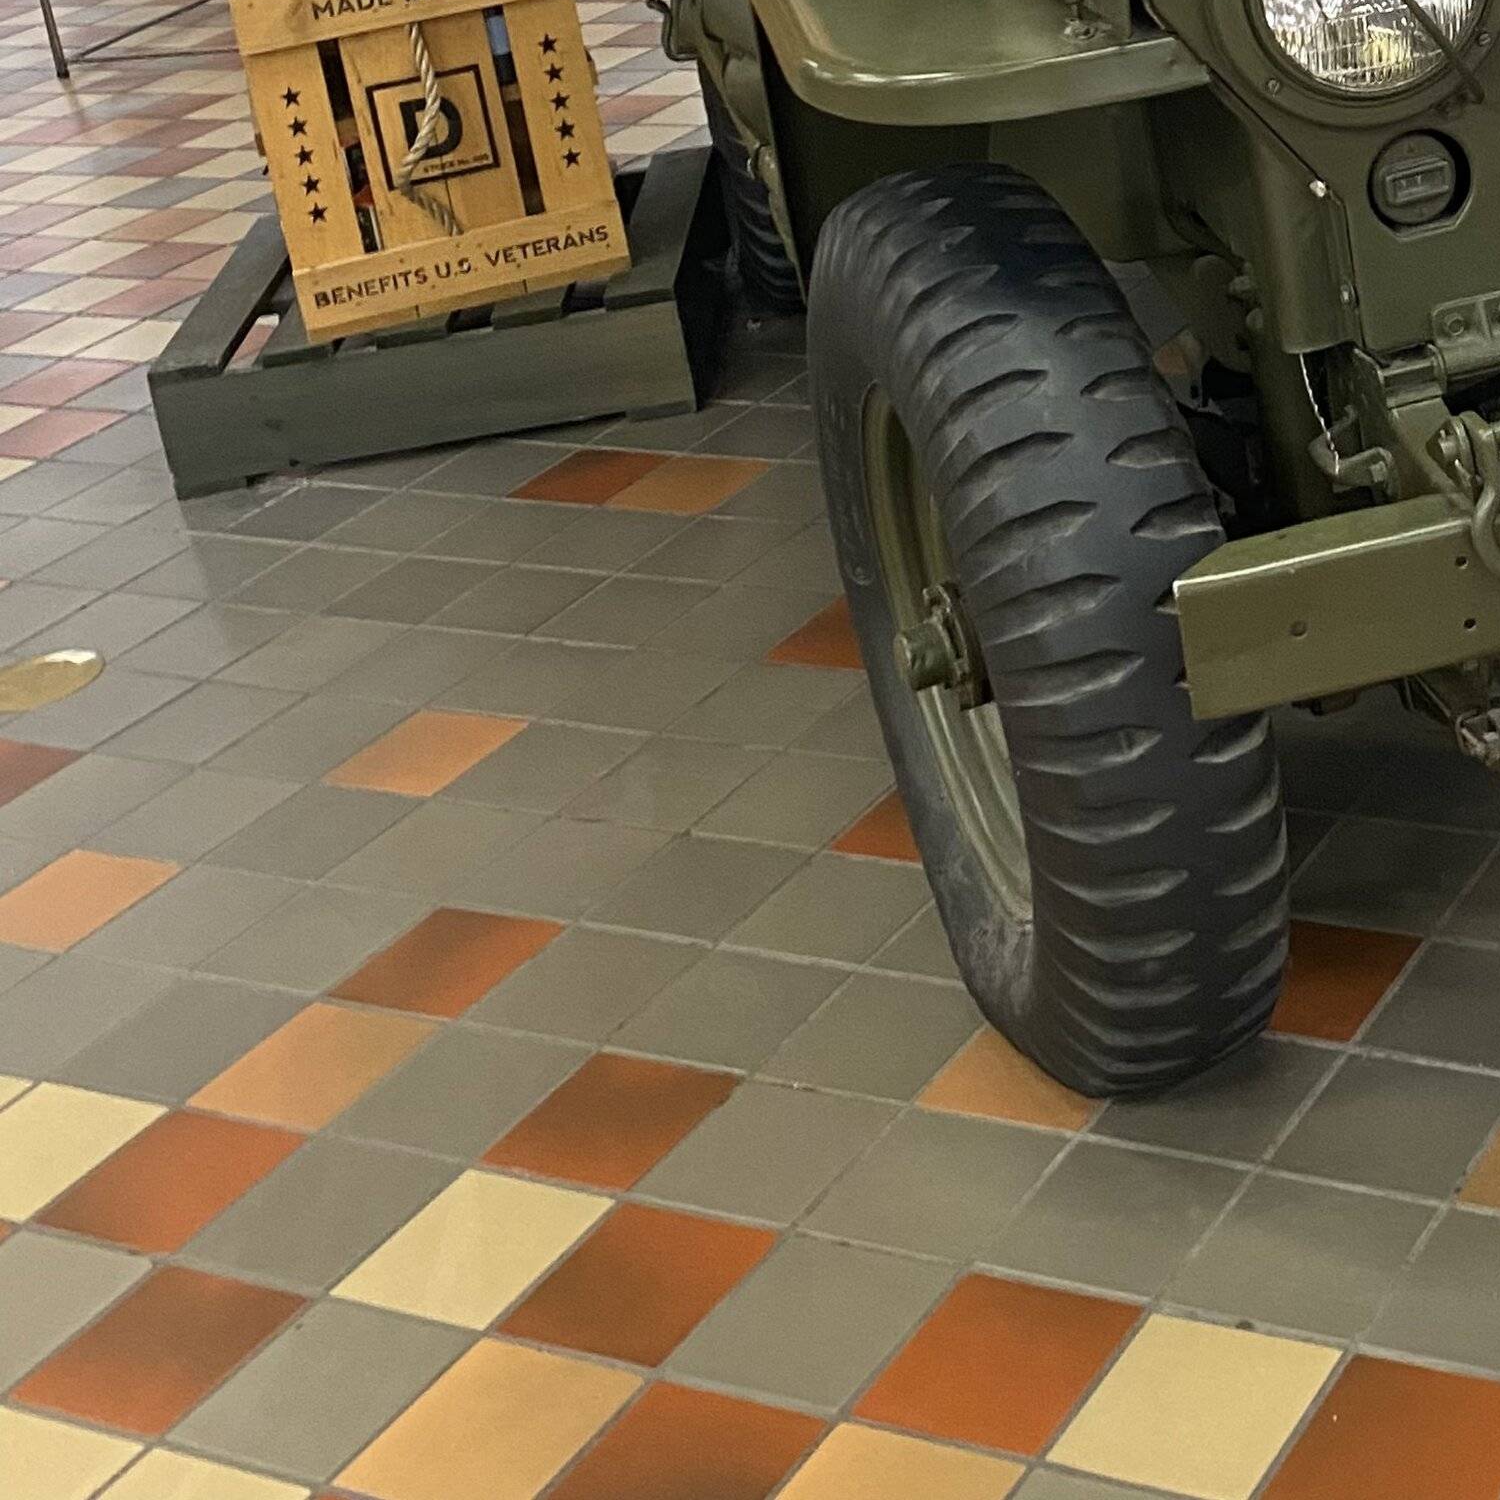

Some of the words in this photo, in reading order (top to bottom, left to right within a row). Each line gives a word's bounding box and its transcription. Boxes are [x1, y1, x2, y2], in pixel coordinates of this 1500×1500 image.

[314, 266, 429, 310] BENEFITS
[434, 255, 480, 281] U.S.
[484, 224, 610, 268] VETERANS
